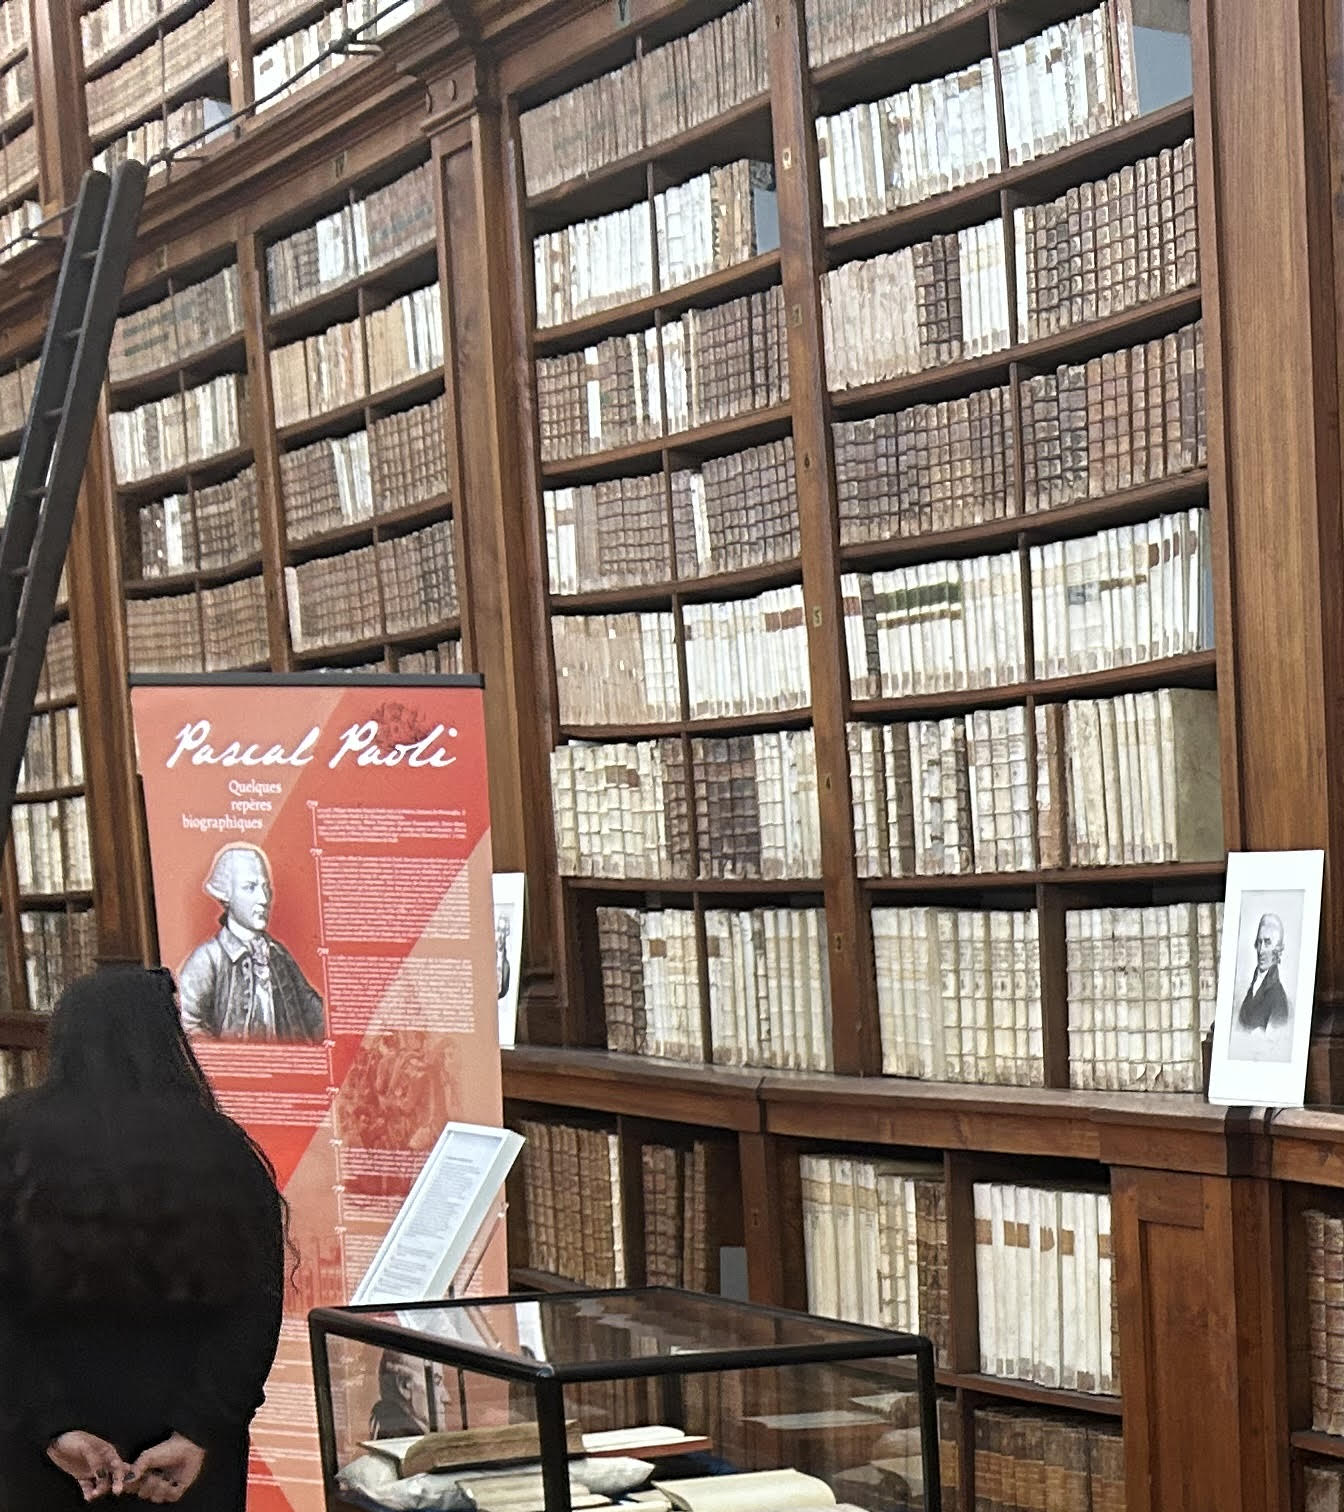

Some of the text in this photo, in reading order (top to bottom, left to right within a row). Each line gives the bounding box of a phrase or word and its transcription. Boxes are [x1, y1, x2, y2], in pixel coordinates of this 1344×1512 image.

[166, 720, 458, 768] Pascal Paoli
[228, 779, 282, 796] Quelques
[230, 798, 273, 812] repères
[182, 814, 263, 832] biographiques
